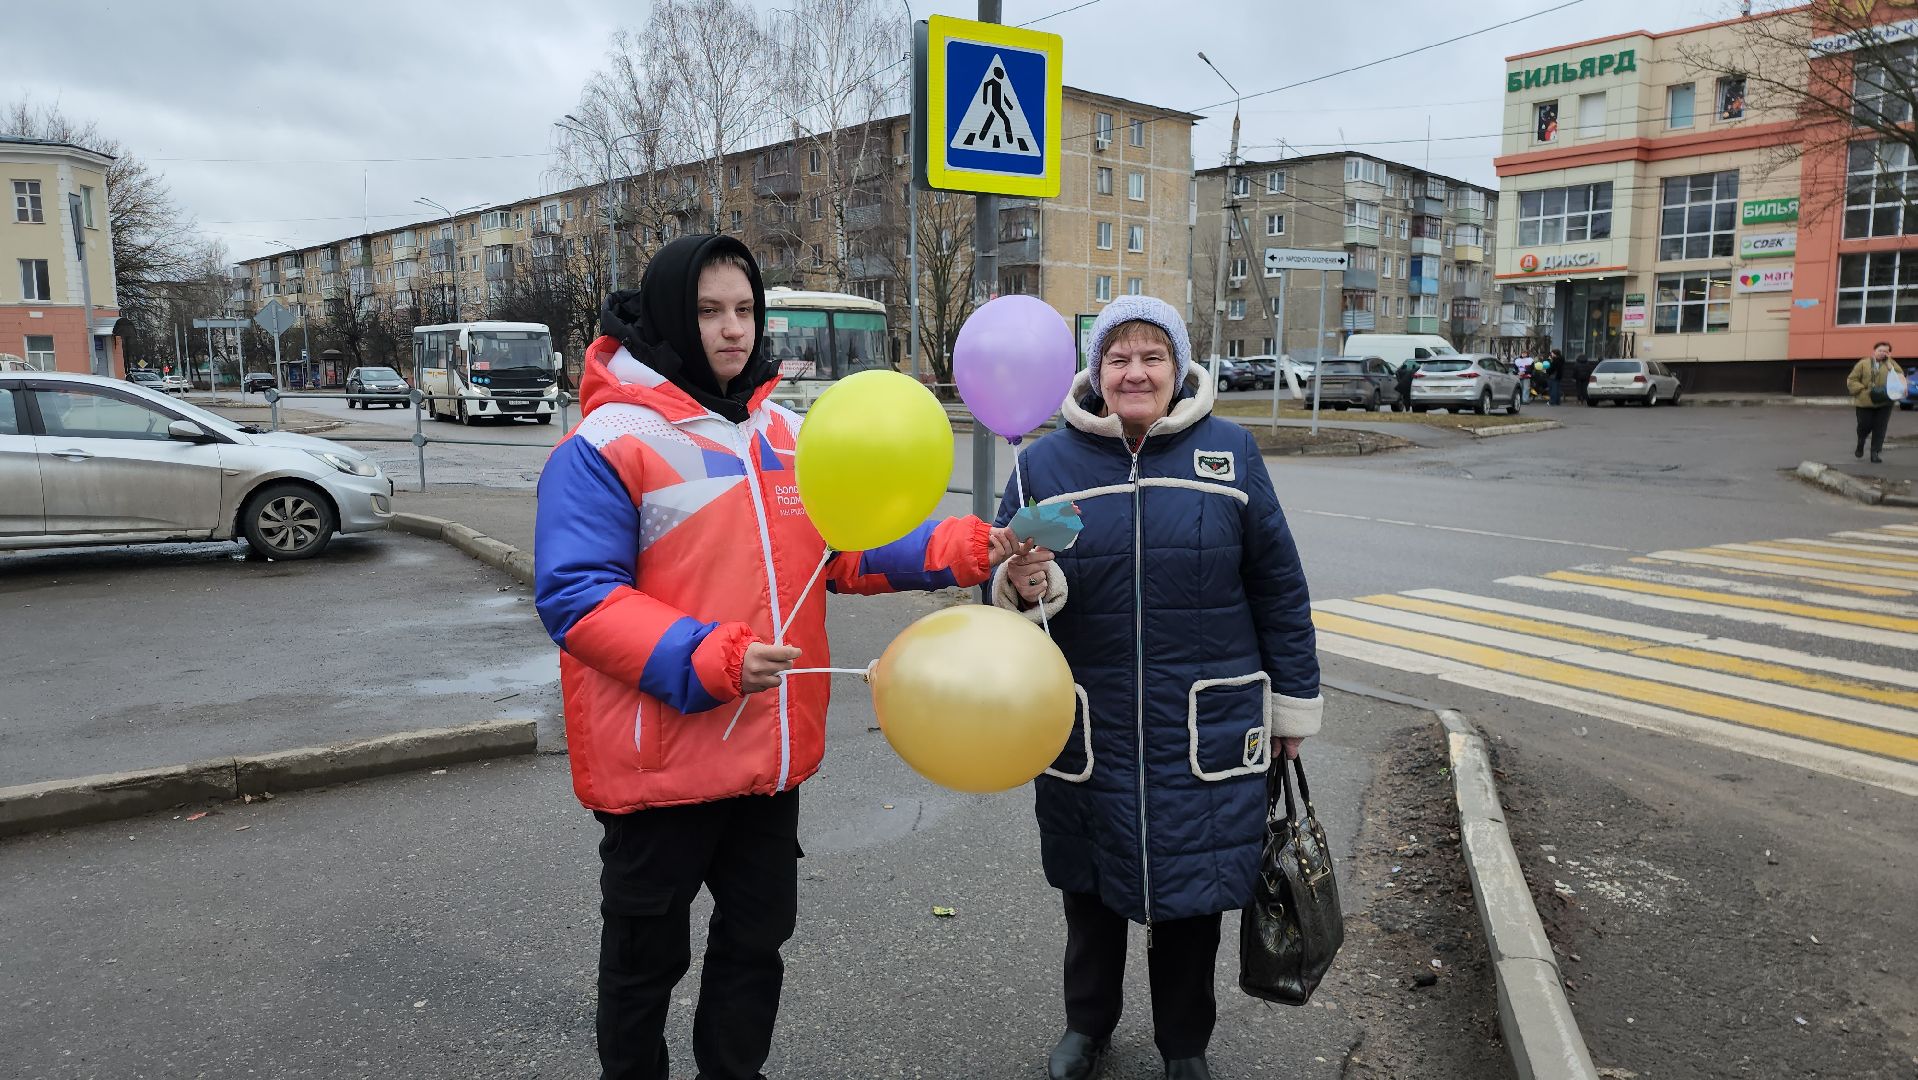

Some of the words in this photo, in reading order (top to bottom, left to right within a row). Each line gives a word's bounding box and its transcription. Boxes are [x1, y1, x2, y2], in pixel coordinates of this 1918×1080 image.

[1508, 49, 1637, 92] БИЛЬЯРД
[1743, 200, 1800, 218] БИЛЬЯ
[1543, 252, 1600, 270] ДИКСИ
